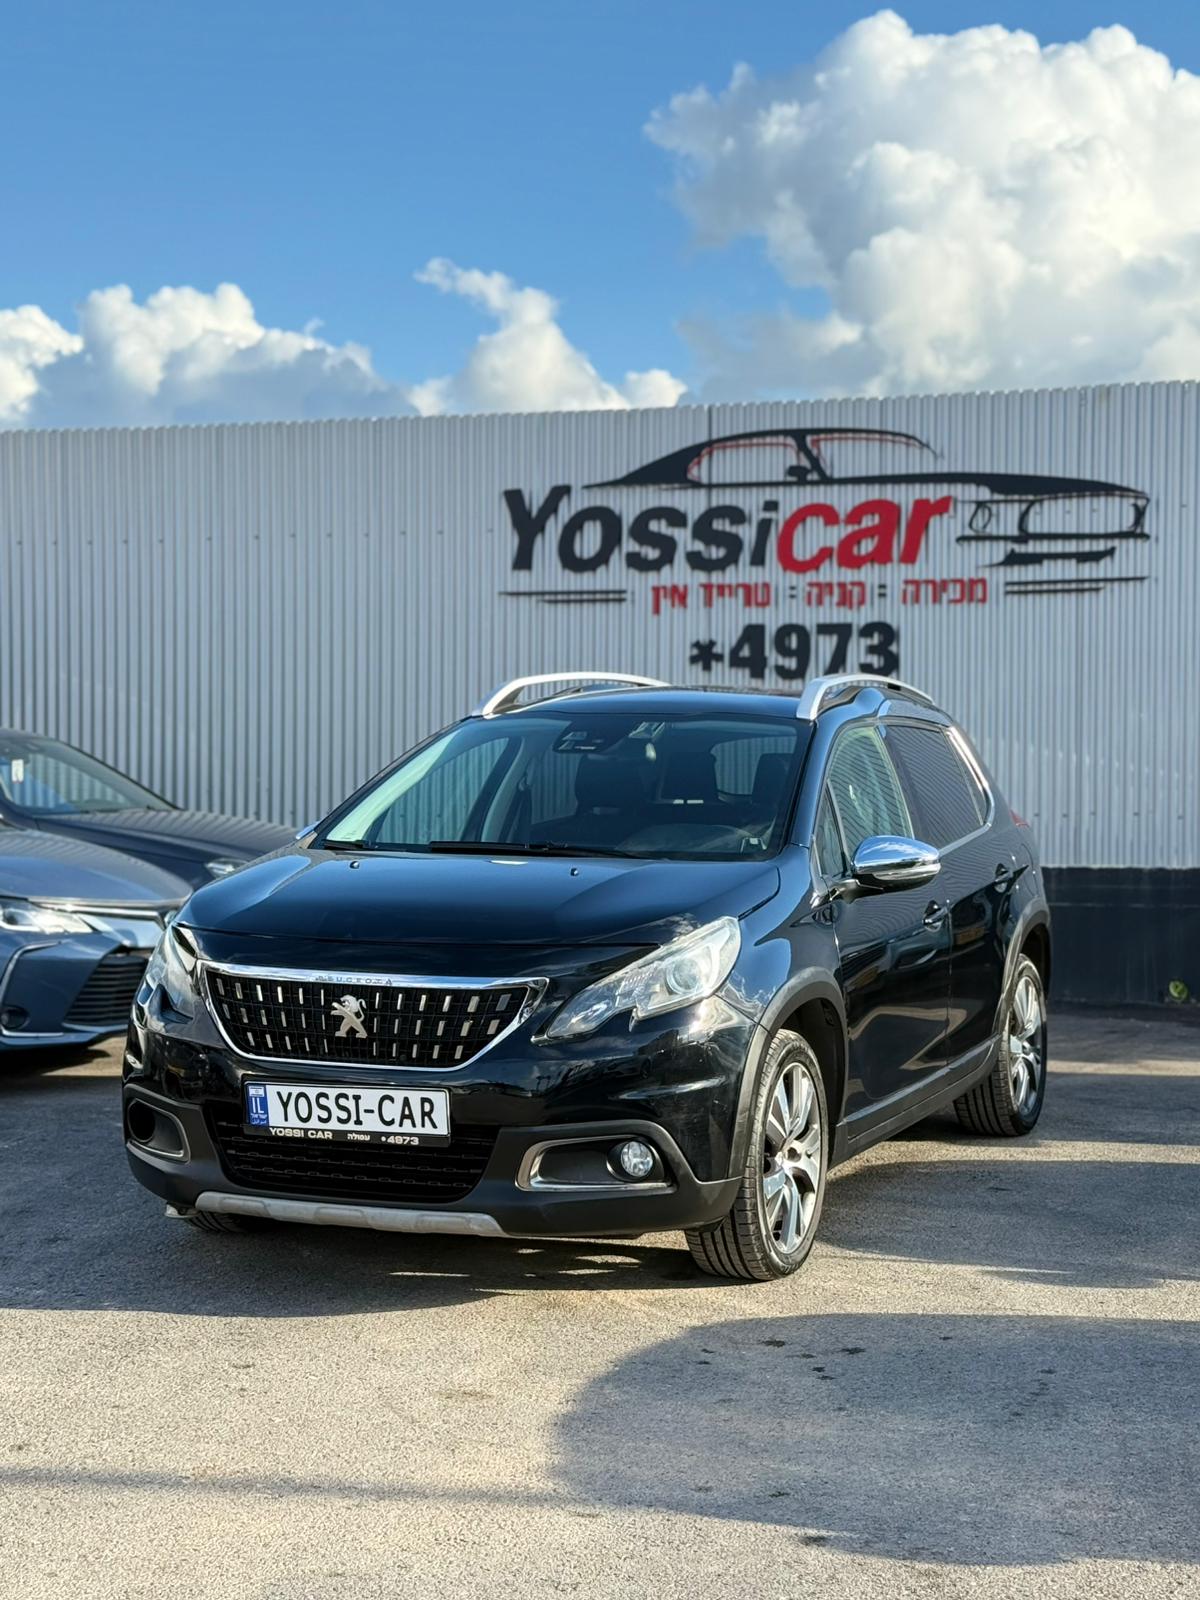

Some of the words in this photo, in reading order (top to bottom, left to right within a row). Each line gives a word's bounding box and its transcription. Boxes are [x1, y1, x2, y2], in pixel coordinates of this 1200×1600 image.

[650, 583, 688, 615] אין
[699, 581, 771, 609] טרייד
[806, 580, 866, 611] קניה
[902, 577, 987, 605] מכירה
[251, 1097, 265, 1114] IL
[276, 1090, 438, 1129] YOSSI-CAR
[269, 1127, 304, 1138] YOSSI
[307, 1131, 333, 1139] CAR
